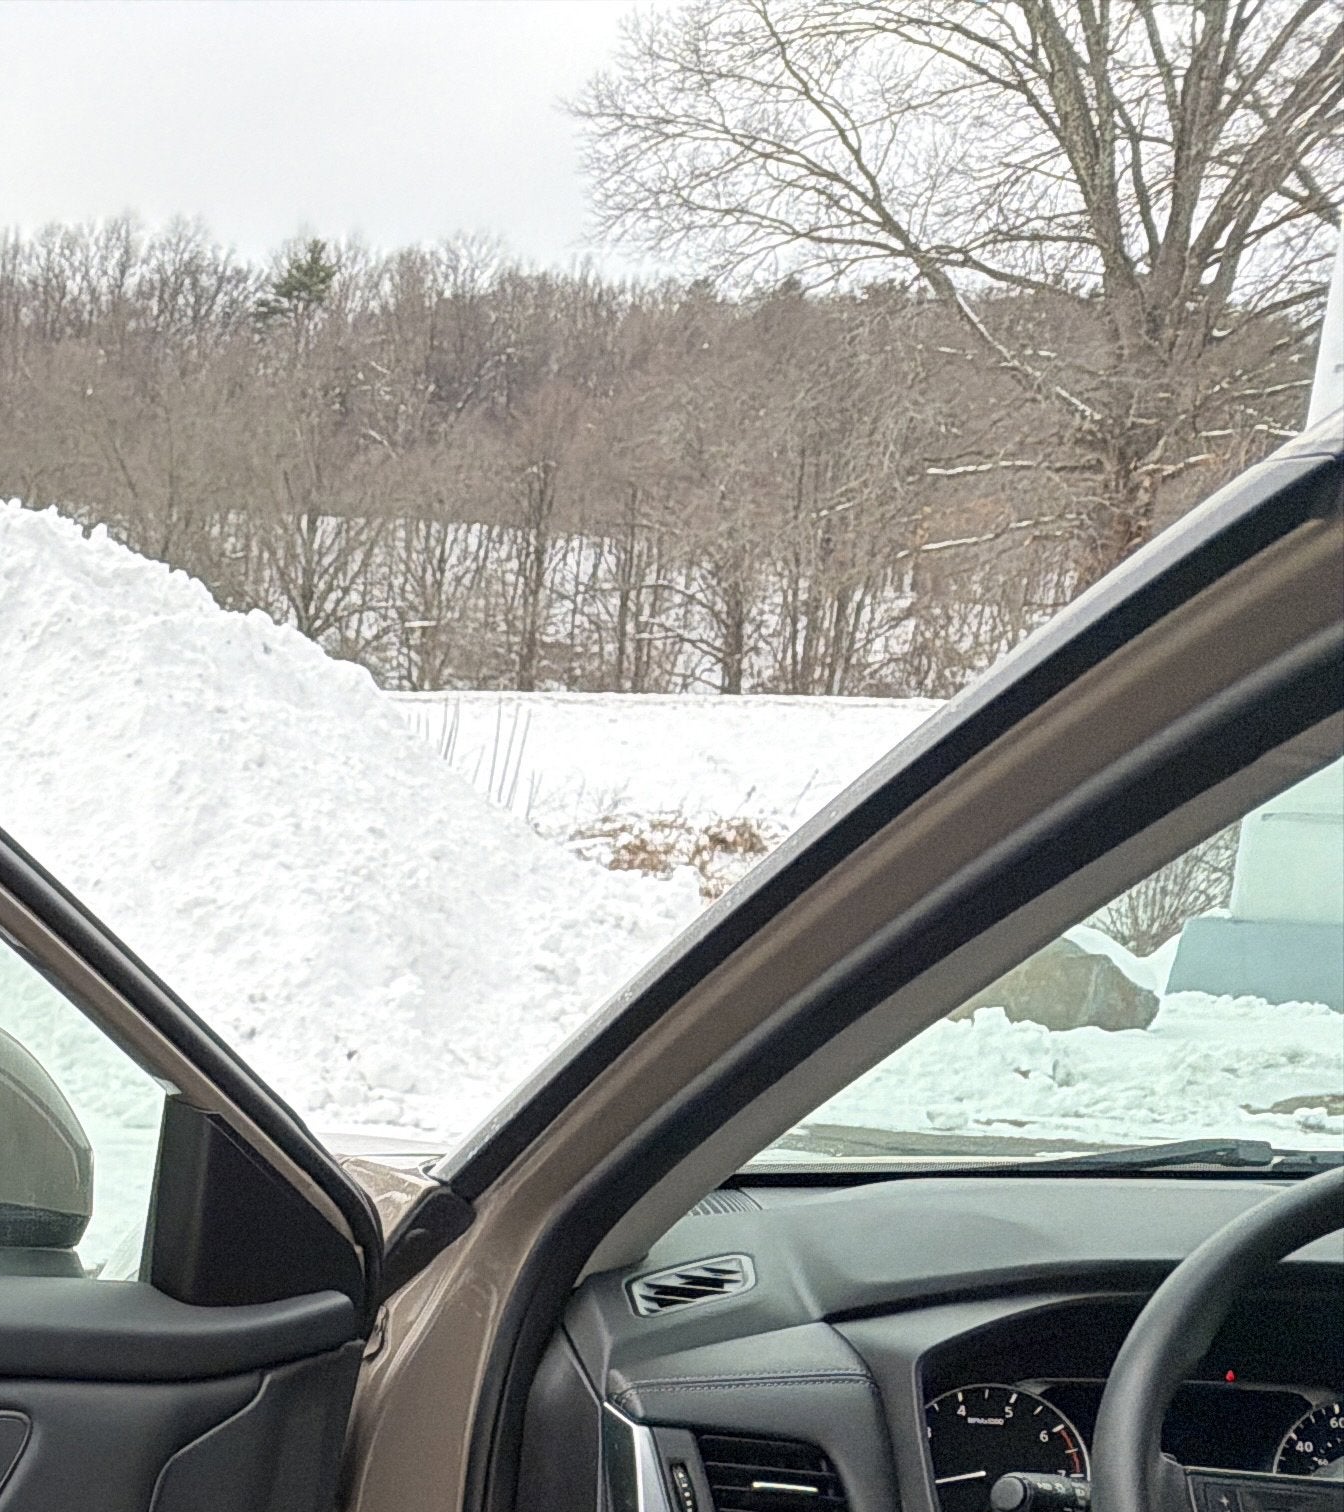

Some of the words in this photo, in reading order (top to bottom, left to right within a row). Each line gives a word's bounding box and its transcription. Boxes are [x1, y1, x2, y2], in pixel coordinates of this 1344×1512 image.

[956, 1404, 966, 1417] 4
[1004, 1405, 1014, 1419] 5
[1329, 1416, 1344, 1429] 60
[1039, 1430, 1049, 1442] 6
[1295, 1440, 1314, 1453] 40
